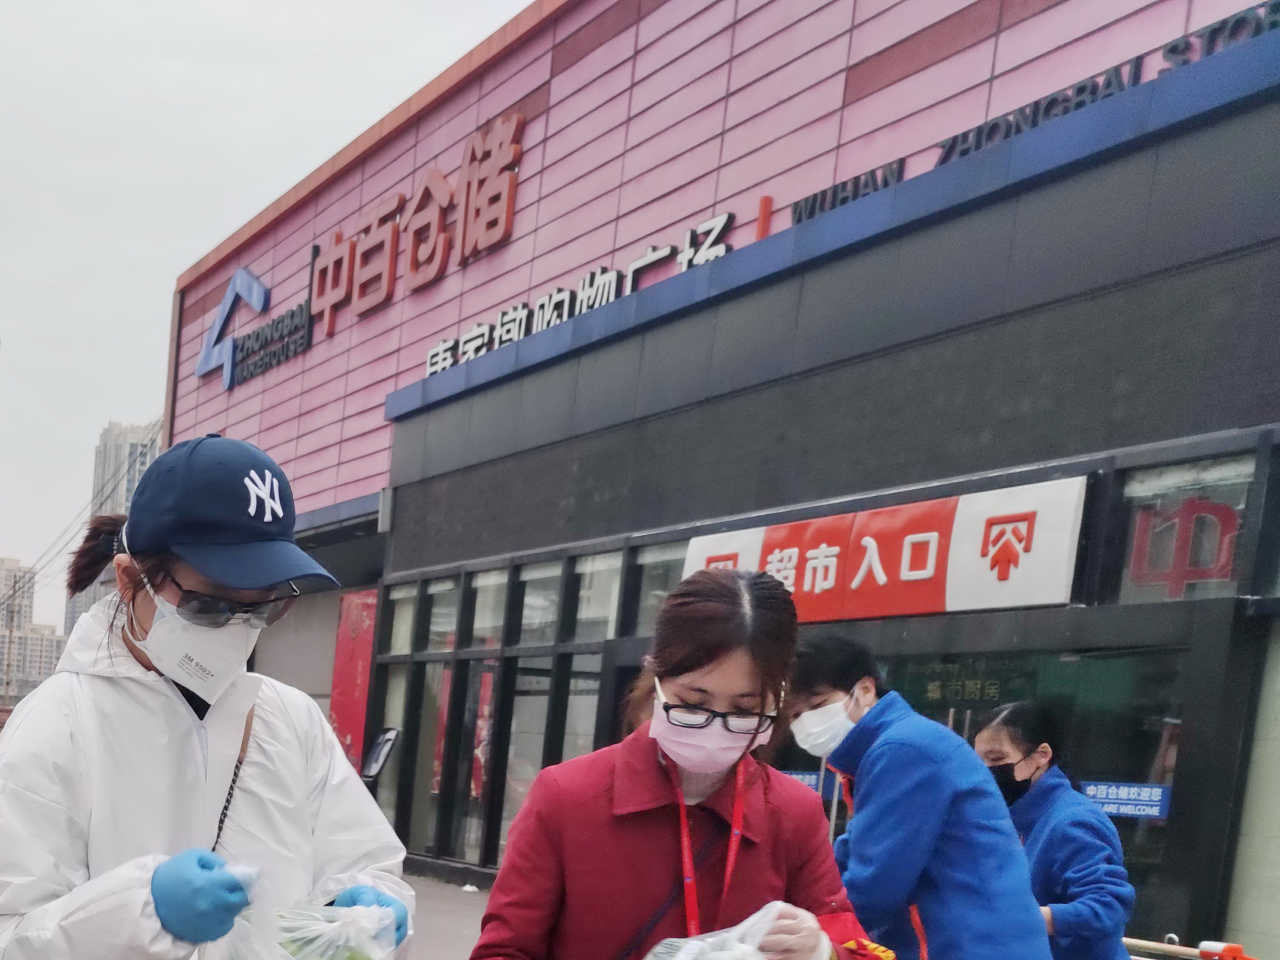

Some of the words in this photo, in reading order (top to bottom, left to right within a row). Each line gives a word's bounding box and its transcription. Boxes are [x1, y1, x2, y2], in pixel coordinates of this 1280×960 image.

[311, 113, 524, 338] 中百仓储
[244, 469, 283, 522] NY
[766, 531, 940, 594] 超市入口
[1086, 785, 1162, 801] 中百仓储欢迎您
[1119, 805, 1160, 816] WELCOME
